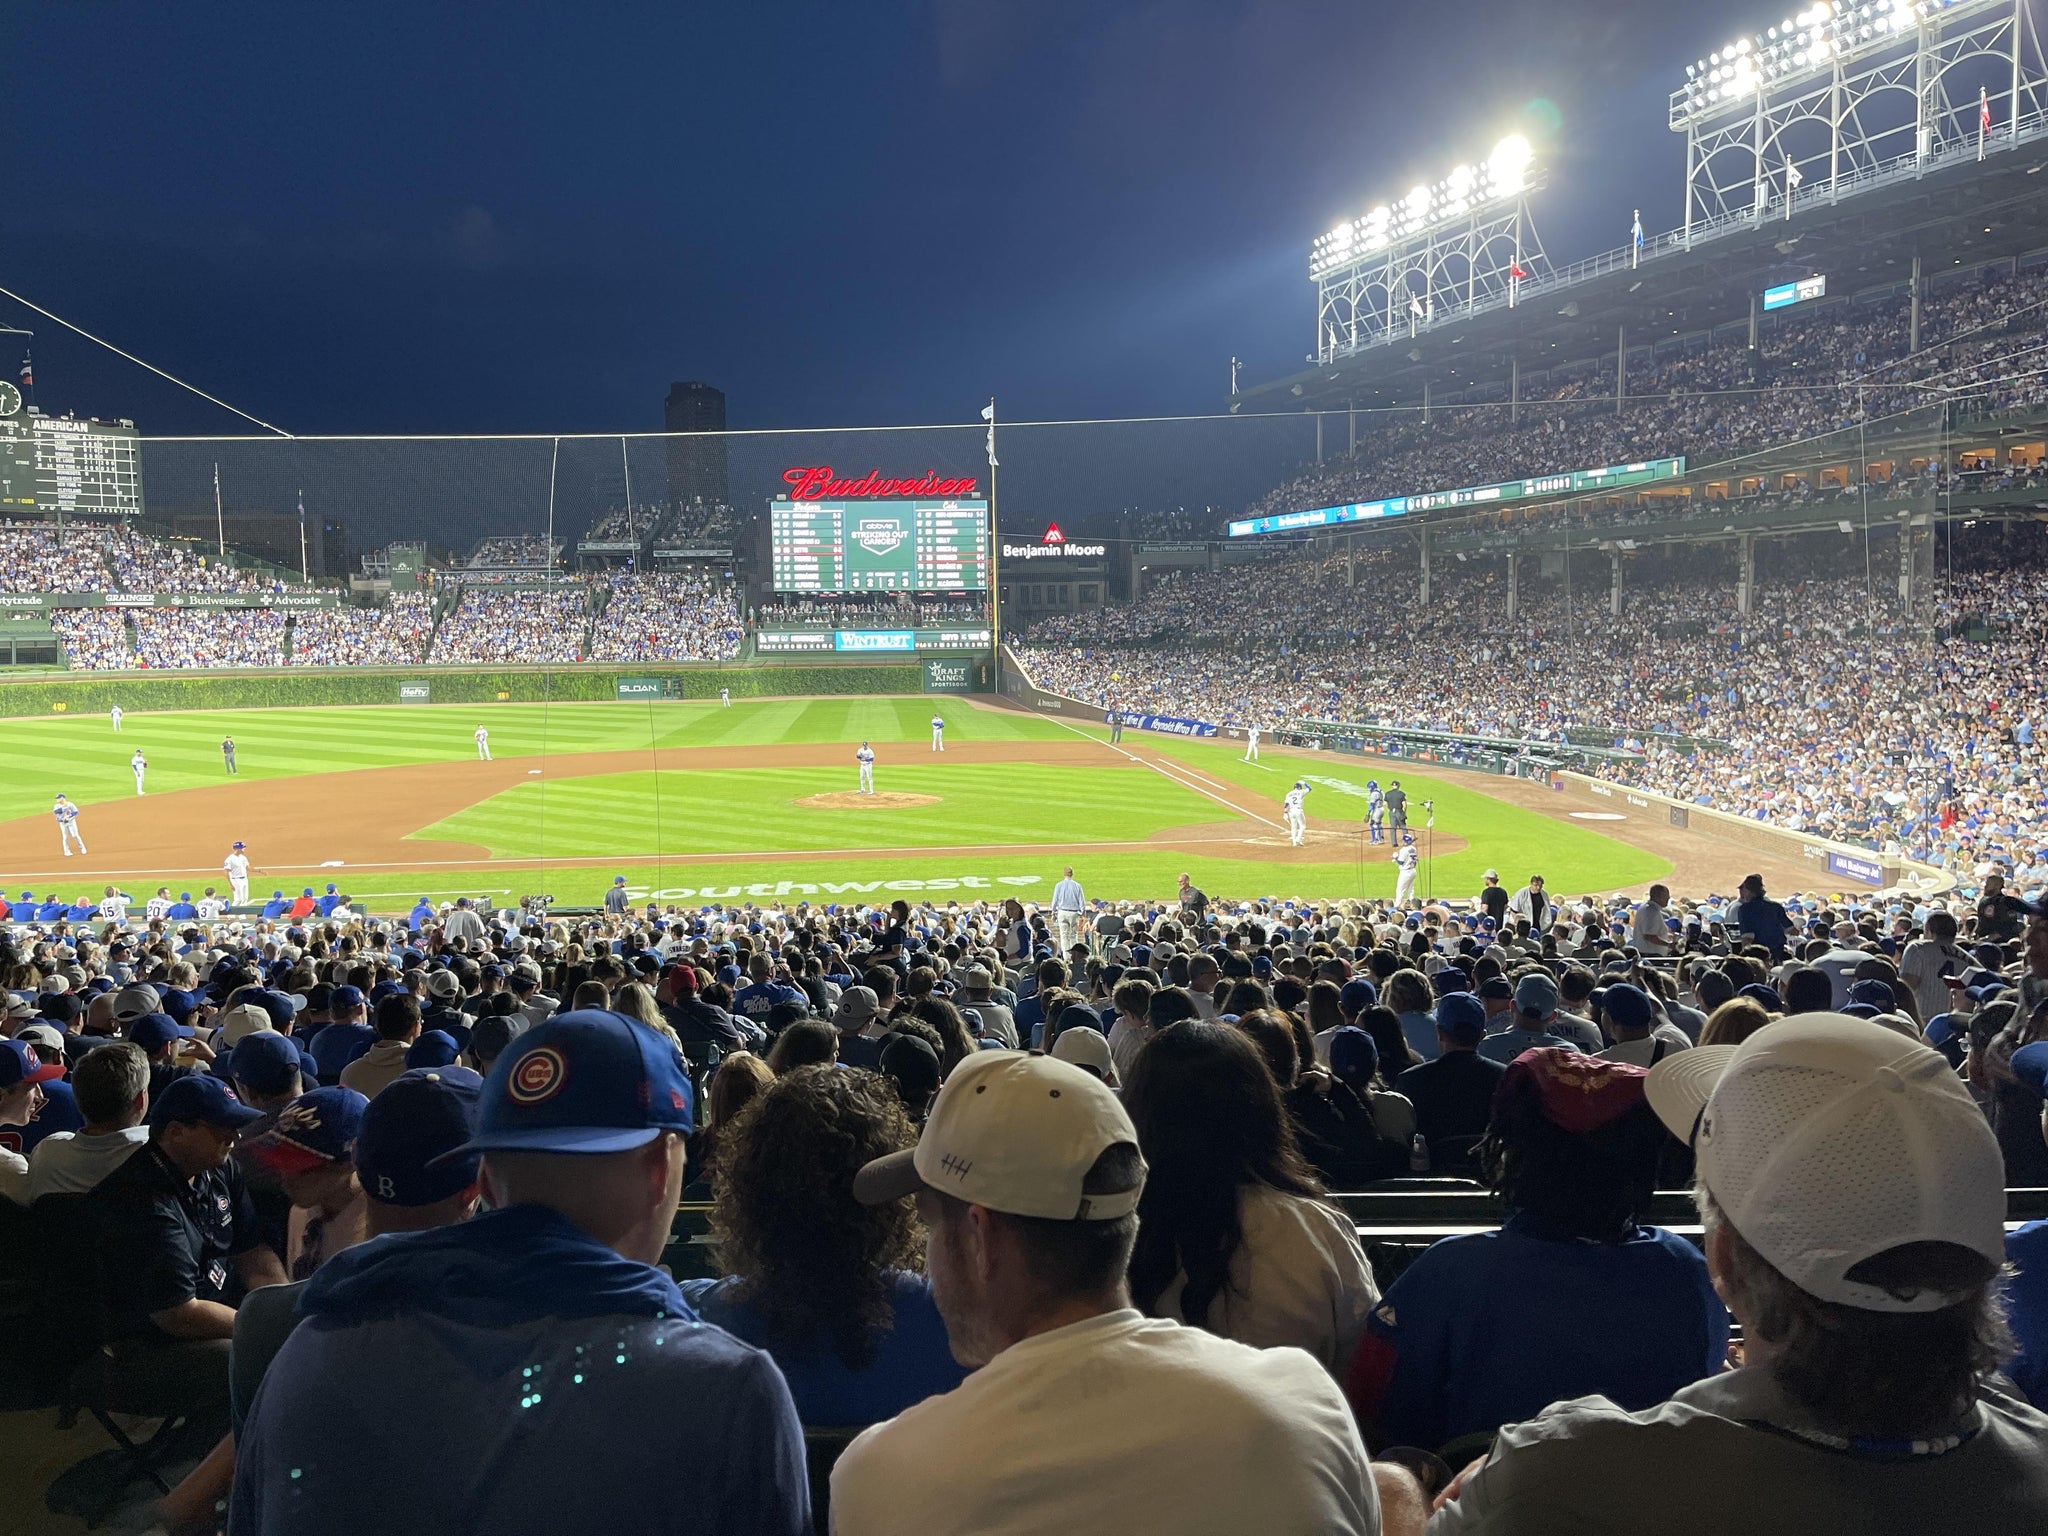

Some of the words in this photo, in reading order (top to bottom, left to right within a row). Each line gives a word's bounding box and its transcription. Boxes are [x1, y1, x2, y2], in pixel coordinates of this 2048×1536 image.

[32, 419, 88, 432] AMERICAN
[782, 467, 977, 500] Budweiser
[892, 530, 909, 538] OUT
[1003, 544, 1060, 559] Benjamin
[1064, 544, 1105, 556] Moore
[105, 594, 155, 603] GRAINGER
[274, 596, 322, 605] Advocate
[841, 632, 911, 648] WINTRUST
[931, 667, 966, 676] DRAFT
[403, 687, 427, 697] Hefty
[53, 702, 67, 711] 400
[1151, 718, 1175, 733] Reynolds
[1174, 721, 1191, 735] Wrap
[1847, 860, 1870, 876] Business
[624, 875, 991, 900] Southwest
[103, 906, 115, 918] 15
[147, 906, 161, 917] 20
[200, 906, 207, 918] 3
[378, 1175, 396, 1199] B
